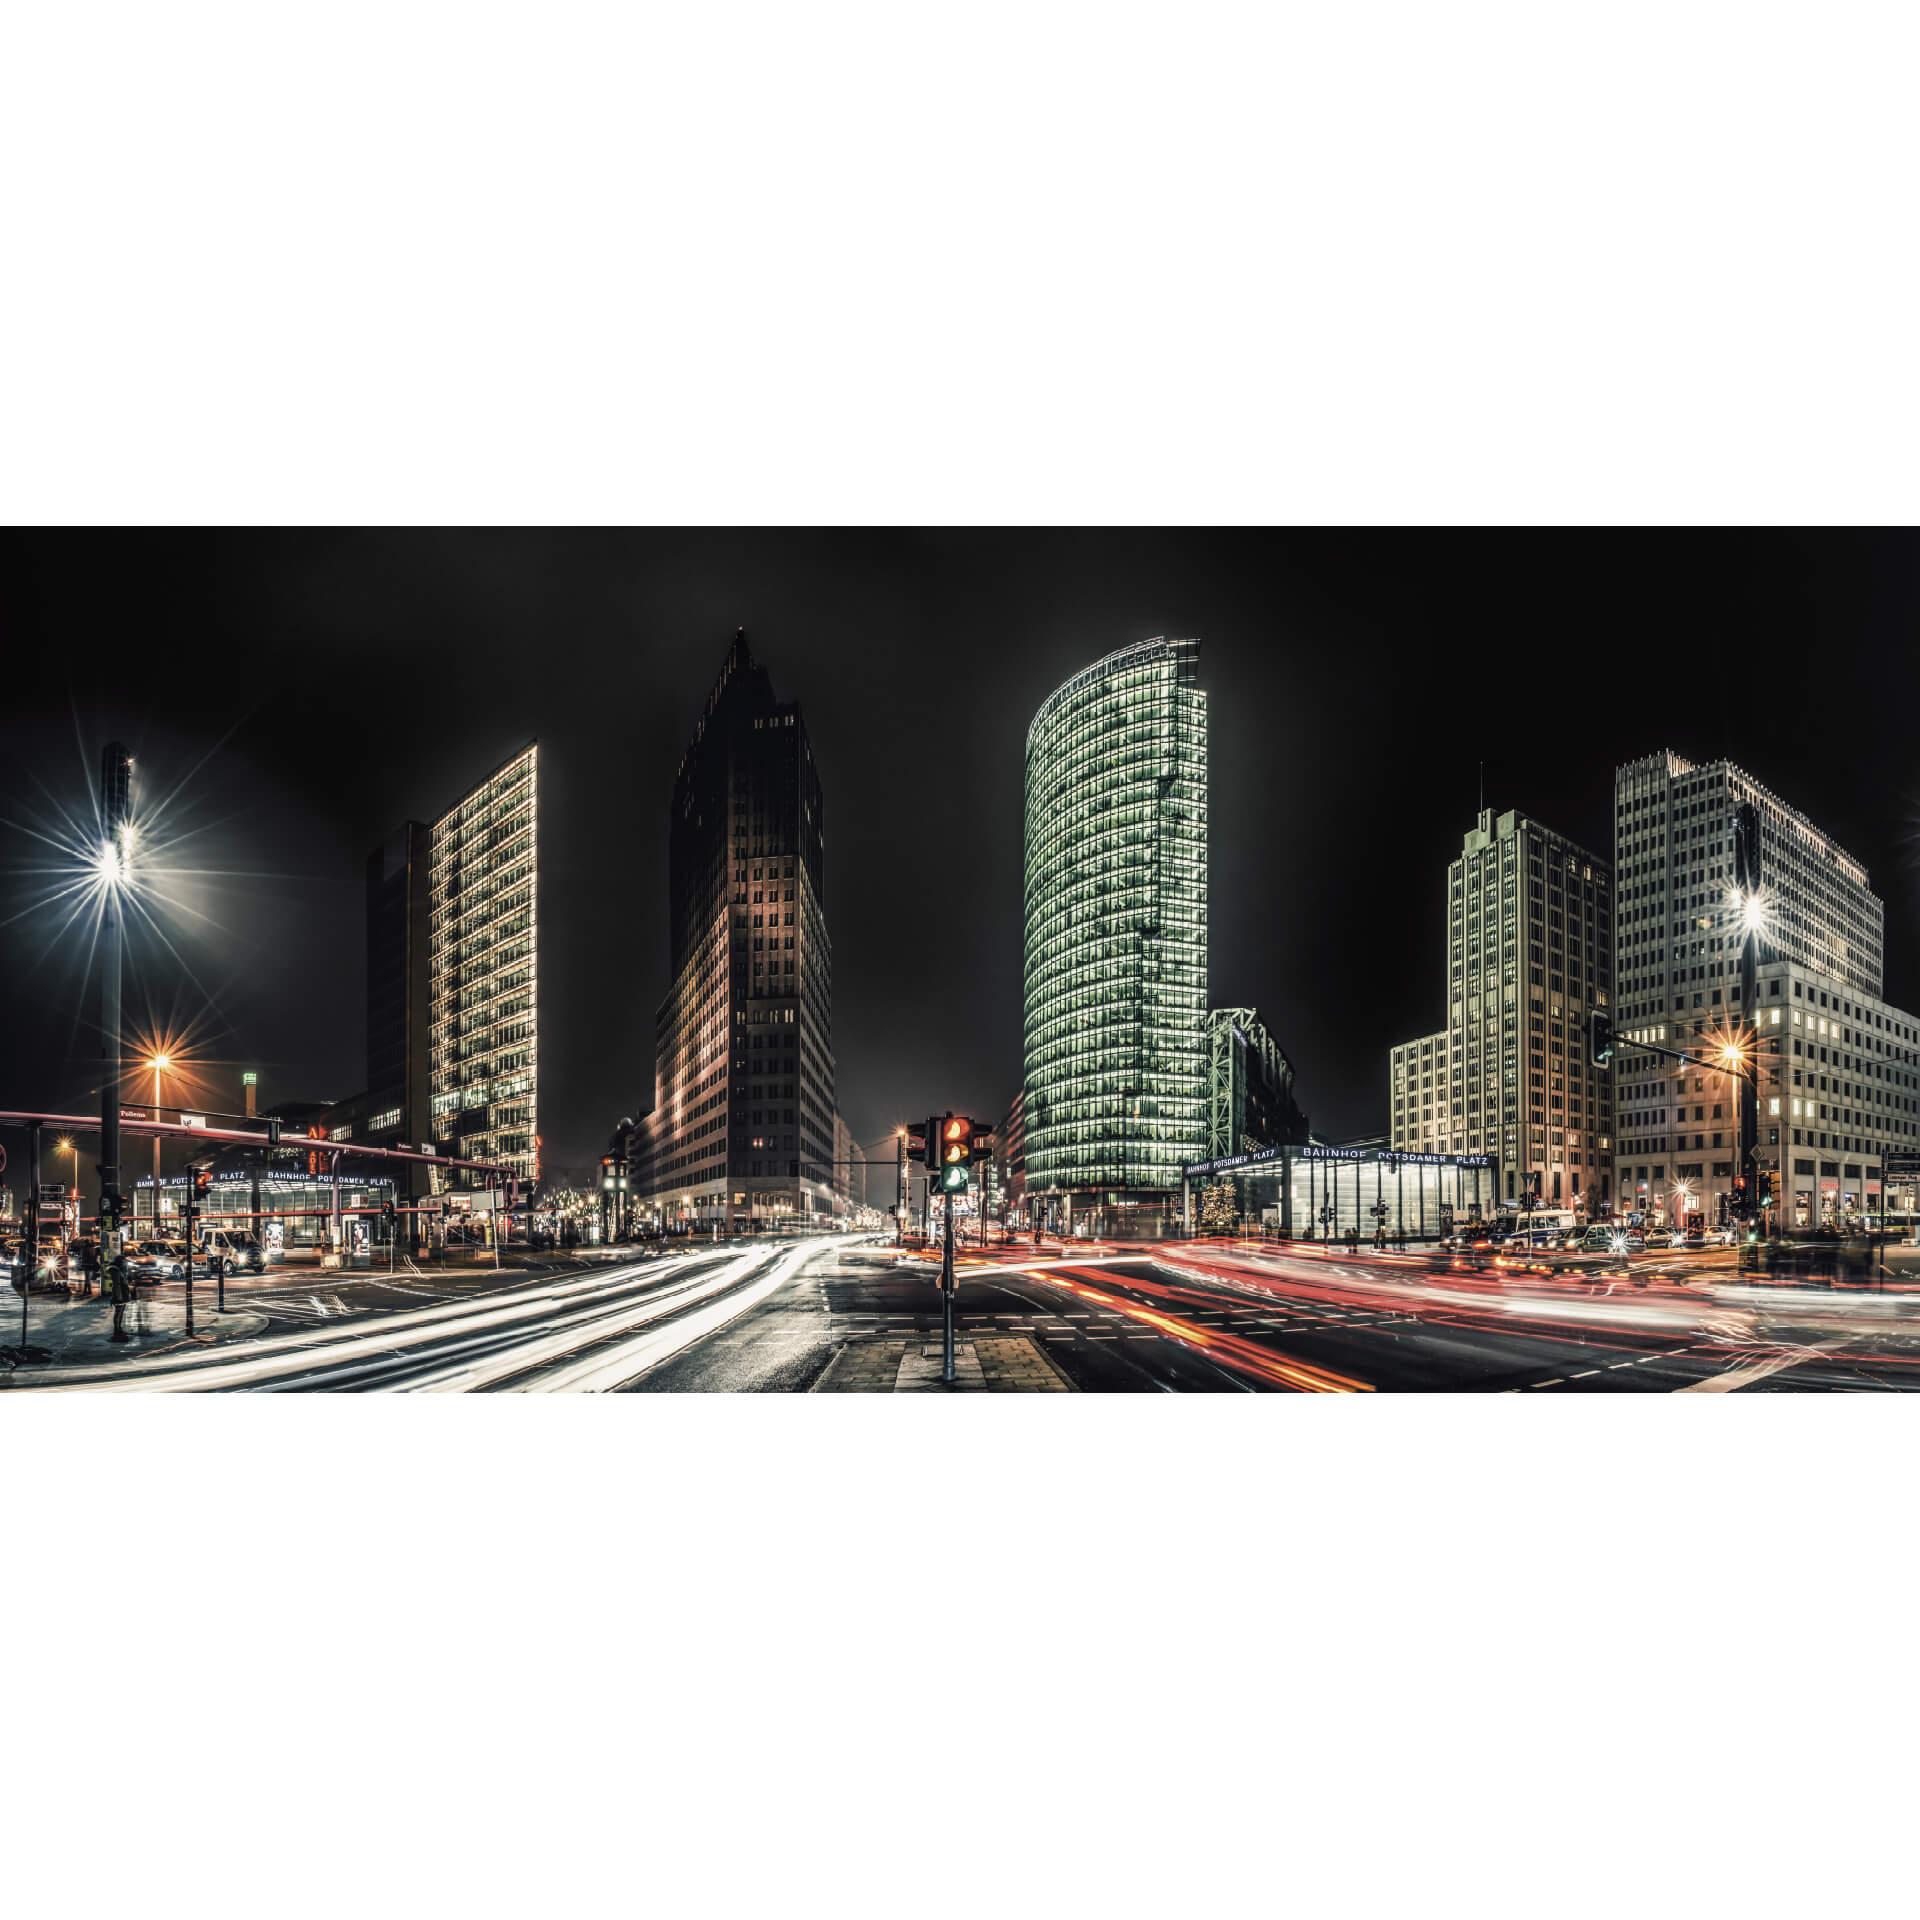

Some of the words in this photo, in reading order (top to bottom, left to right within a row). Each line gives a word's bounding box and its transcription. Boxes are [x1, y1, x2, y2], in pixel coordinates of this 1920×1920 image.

[1213, 1155, 1248, 1169] POTSDAMER
[1253, 1149, 1275, 1160] PLATZ
[1303, 1147, 1367, 1158] BAHNHOF
[1456, 1155, 1488, 1165] PLATZ
[137, 1178, 167, 1188] BAHNOF
[220, 1171, 246, 1180] PLATZ
[267, 1171, 311, 1180] BAHNHOF
[318, 1175, 364, 1184] POTDAMER
